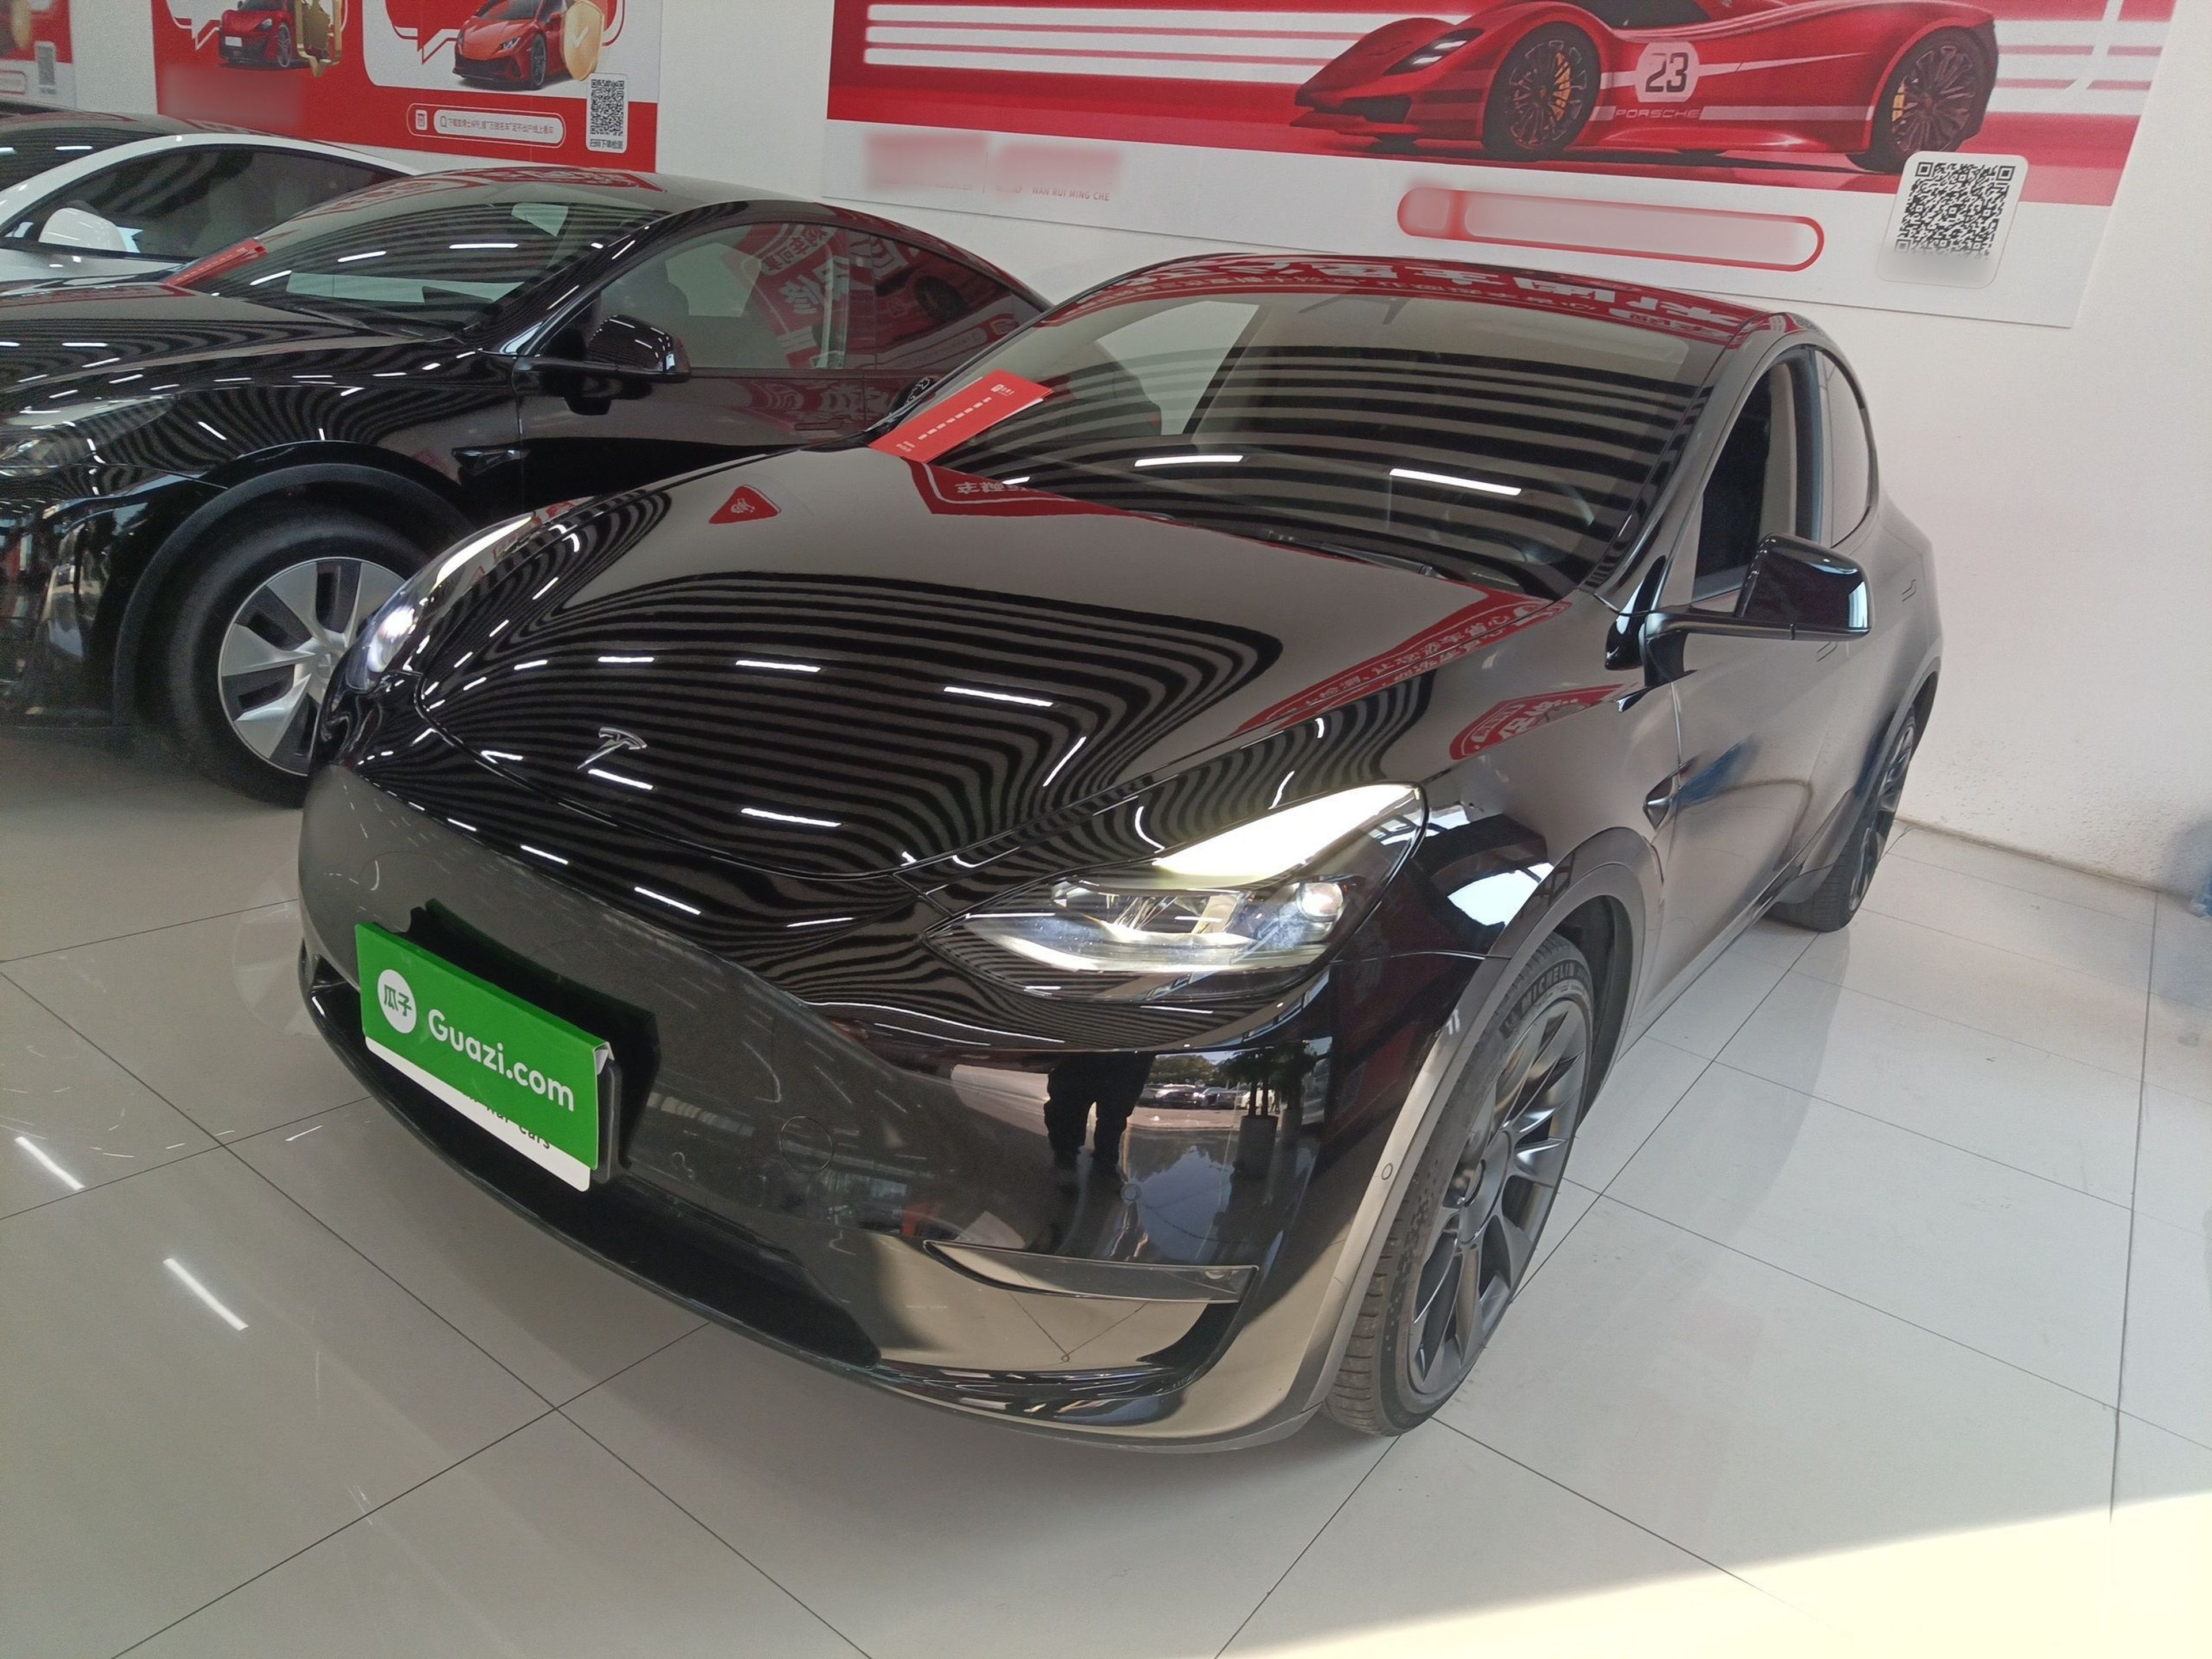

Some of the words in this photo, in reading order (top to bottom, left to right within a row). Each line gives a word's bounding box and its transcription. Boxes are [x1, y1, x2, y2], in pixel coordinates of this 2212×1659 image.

[1645, 52, 1690, 93] 23
[1616, 108, 1701, 119] PORSCHE
[1032, 186, 1049, 195] WAN
[1052, 188, 1066, 197] RUI
[1069, 189, 1090, 199] MING
[1093, 191, 1110, 201] CHE
[384, 984, 413, 1017] 瓜子
[1521, 962, 1577, 1013] MICHELIN
[428, 1008, 574, 1112] Guazi.com
